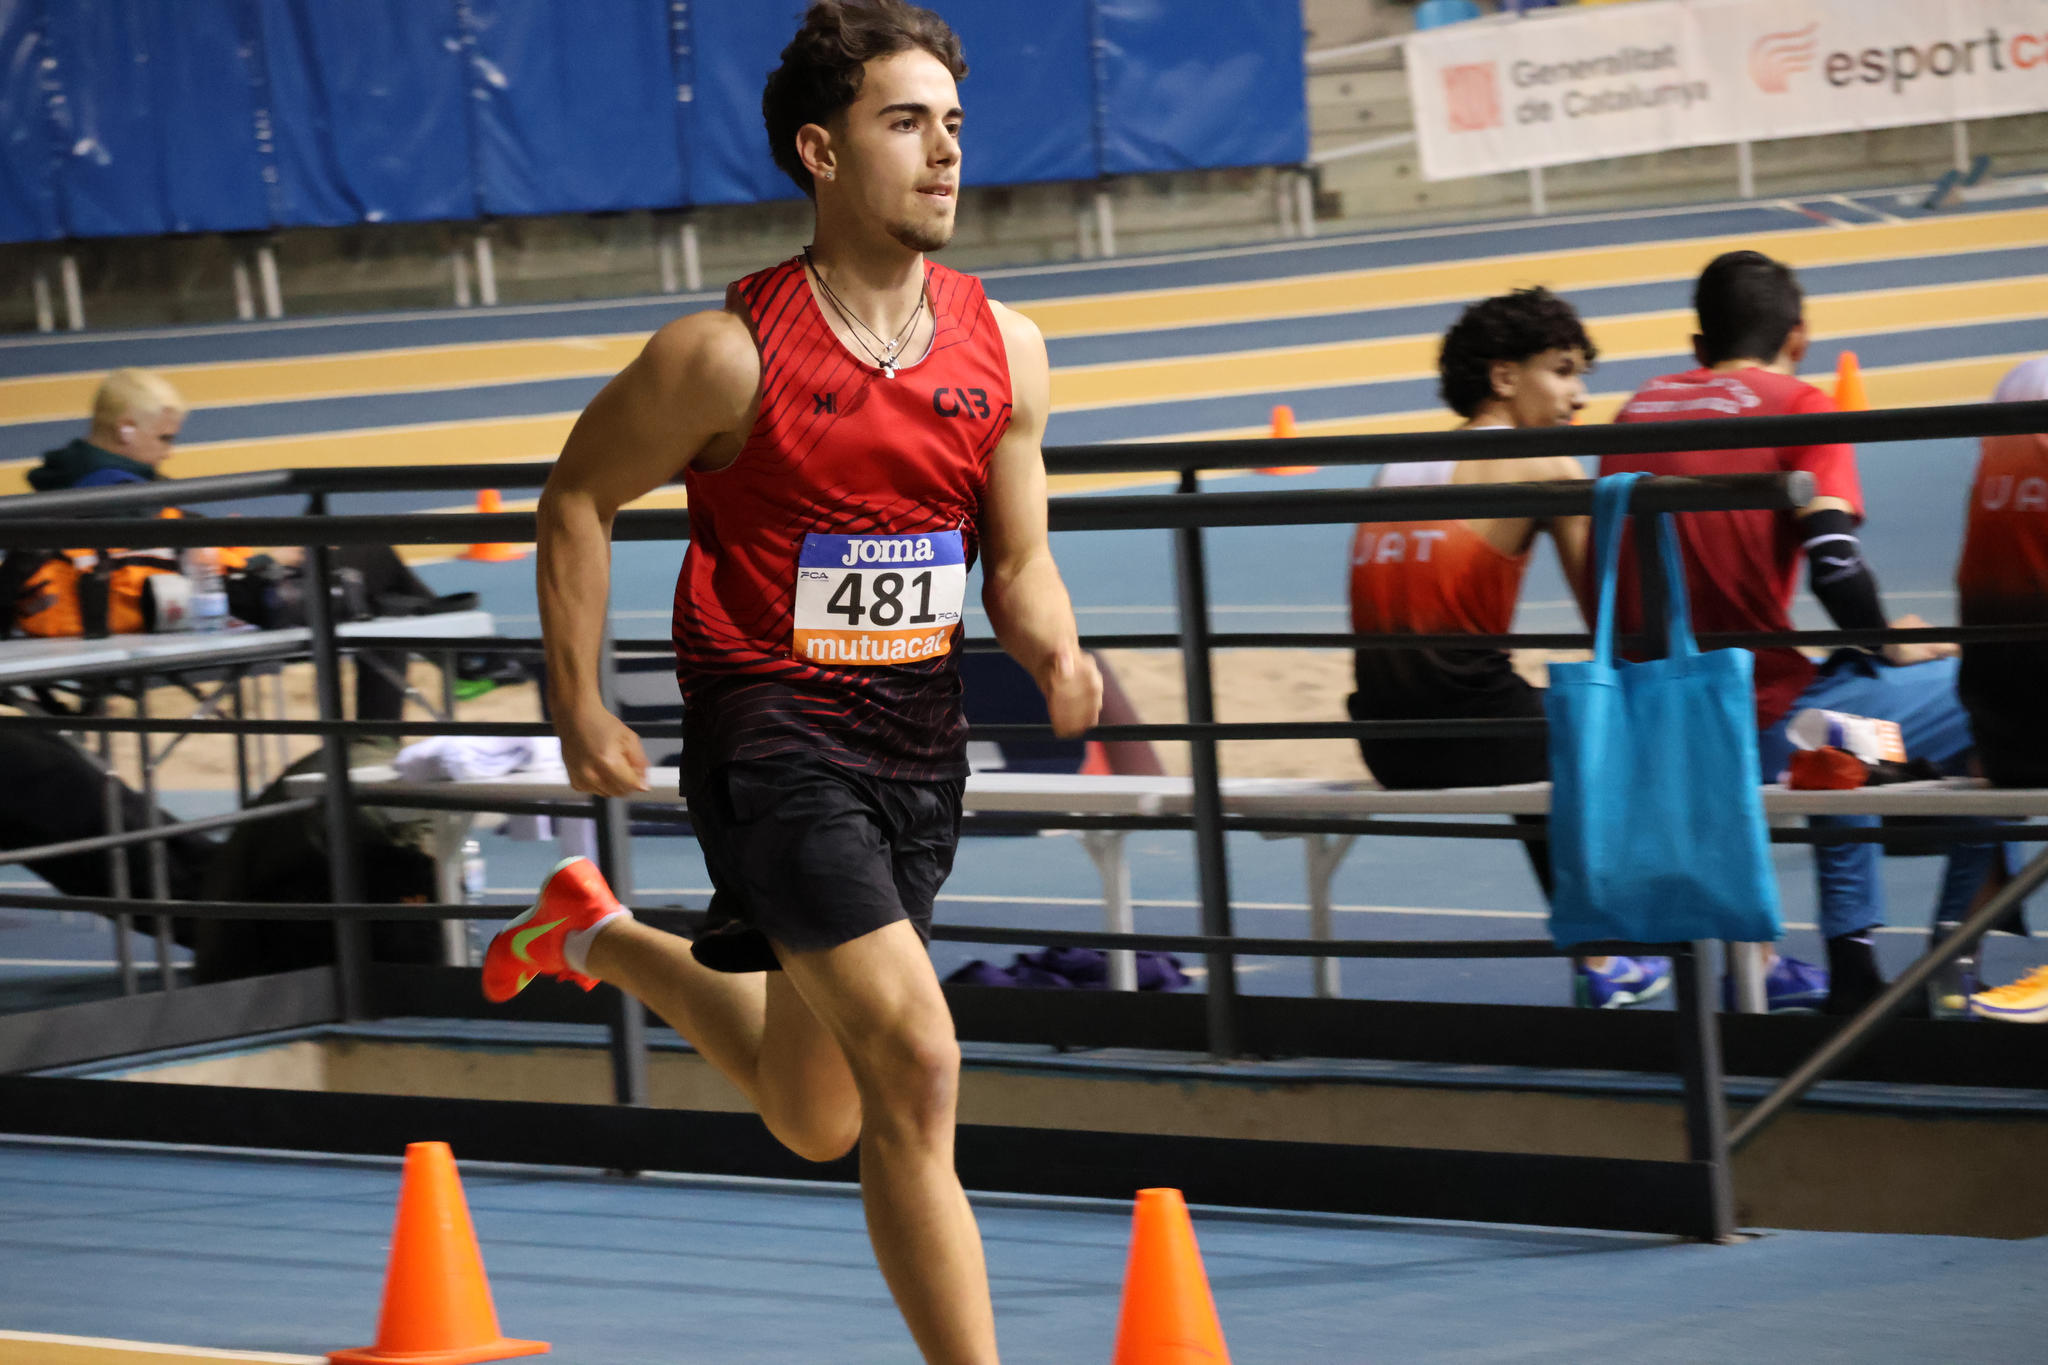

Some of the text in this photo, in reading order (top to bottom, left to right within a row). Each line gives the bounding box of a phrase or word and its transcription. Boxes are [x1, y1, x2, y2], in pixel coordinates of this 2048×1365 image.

[1510, 44, 1677, 88] Generalitat
[1825, 27, 2048, 94] esportc
[1515, 79, 1709, 125] de Catalunya
[826, 571, 936, 627] 481
[806, 629, 946, 661] mutuacat
